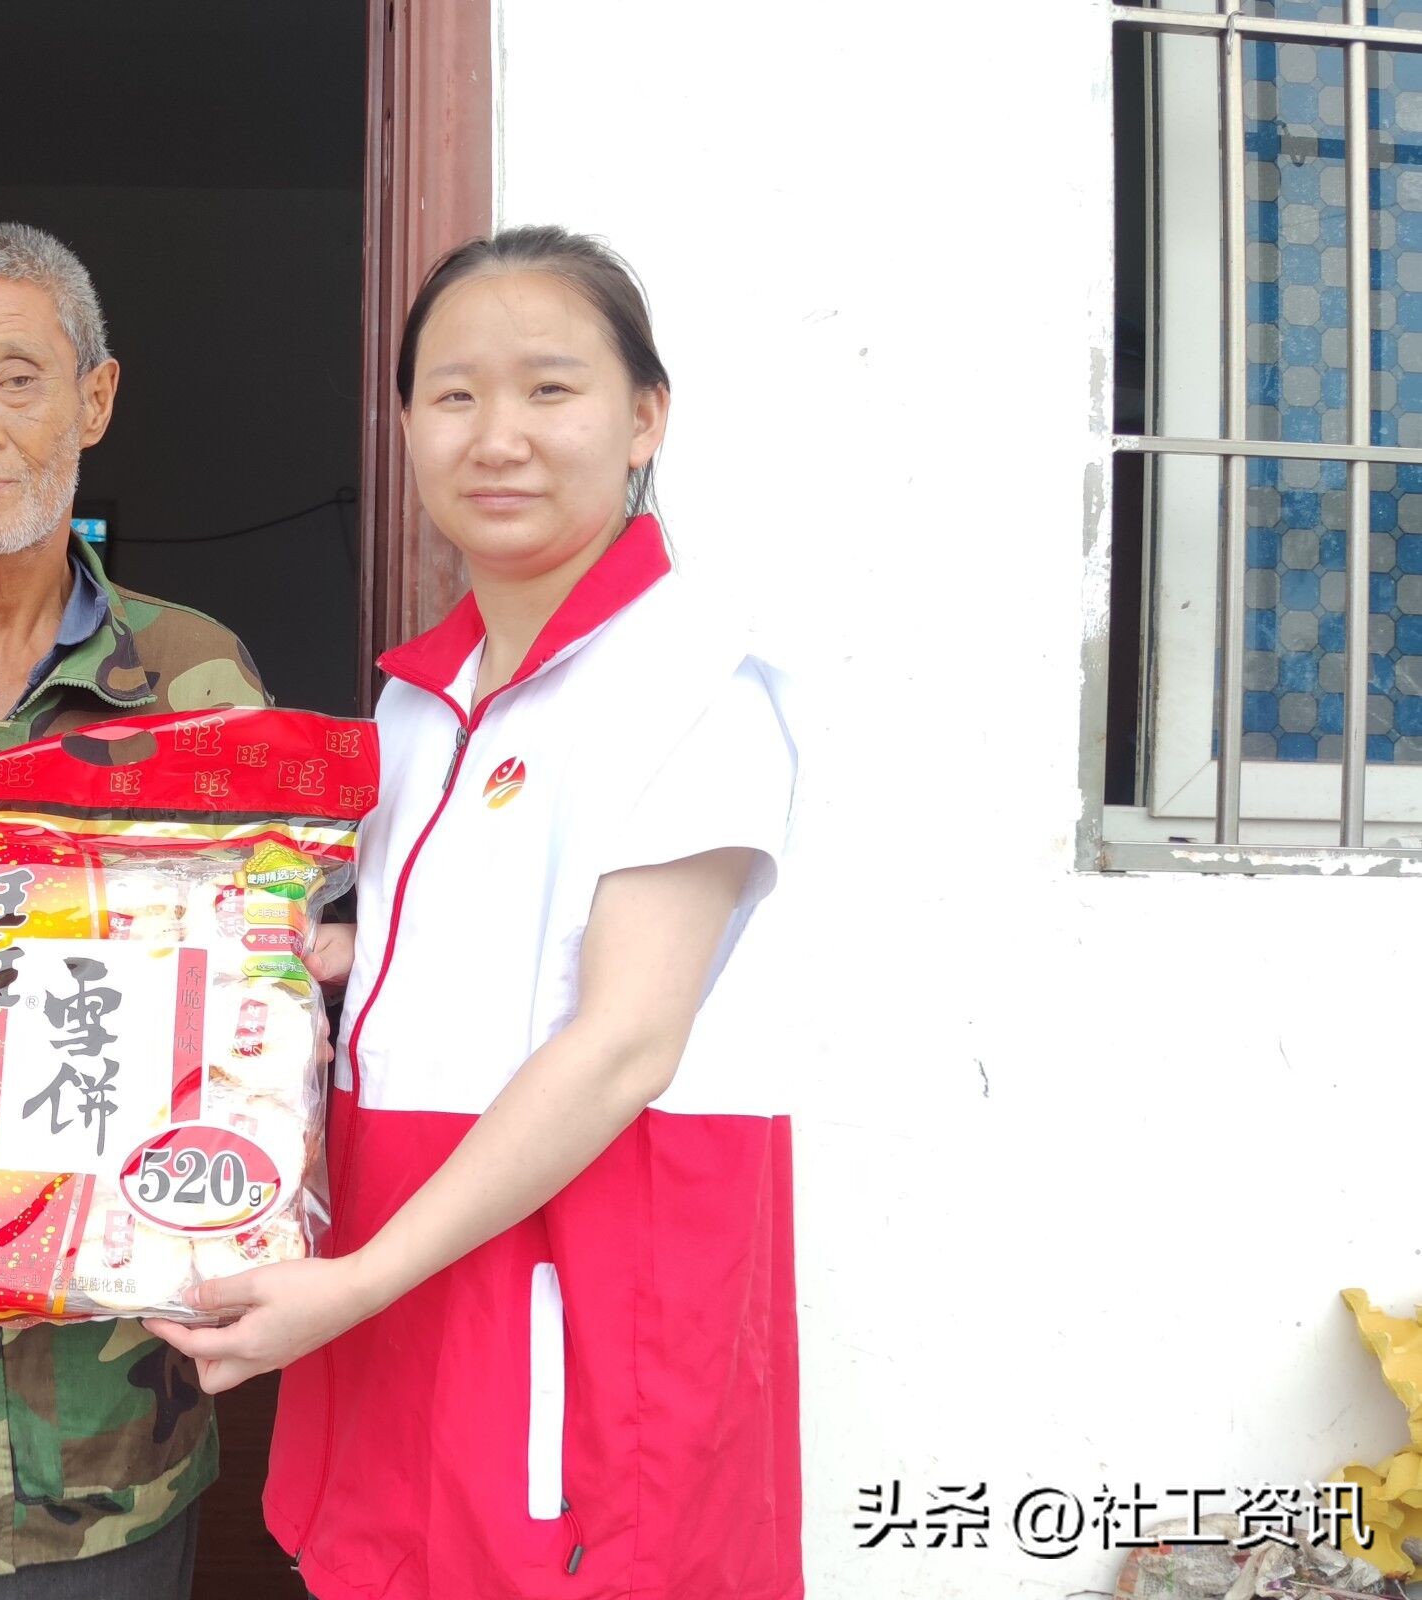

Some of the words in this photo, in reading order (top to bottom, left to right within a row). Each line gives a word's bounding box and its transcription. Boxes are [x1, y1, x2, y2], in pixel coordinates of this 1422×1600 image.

[174, 717, 225, 756] 旺
[326, 728, 361, 759] 旺
[237, 742, 269, 767] 旺
[111, 769, 142, 795] 旺
[195, 769, 231, 797] 旺
[277, 758, 328, 796] 旺
[339, 785, 375, 811] 旺
[247, 867, 318, 884] 使用精选大米
[22, 957, 123, 1156] 雪饼
